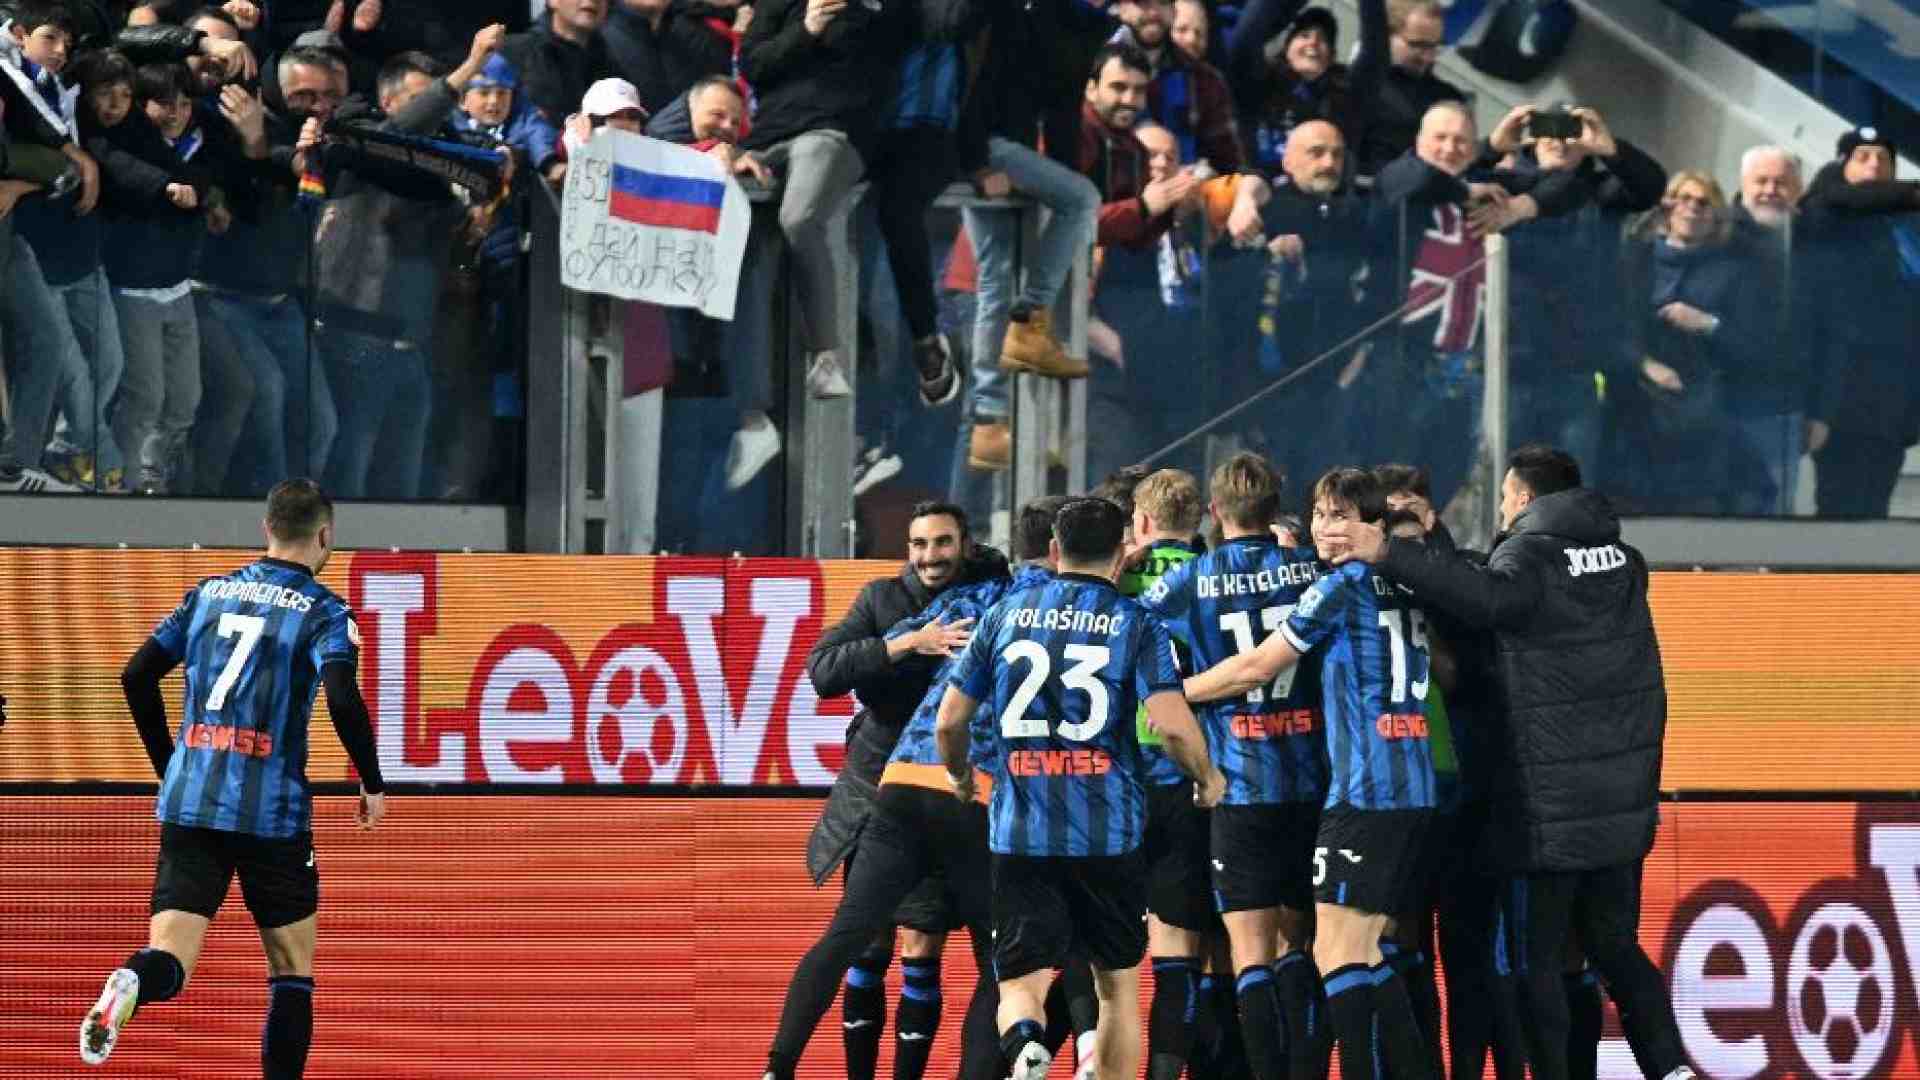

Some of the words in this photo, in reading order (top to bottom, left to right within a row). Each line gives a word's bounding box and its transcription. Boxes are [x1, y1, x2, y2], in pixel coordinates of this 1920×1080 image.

[200, 579, 315, 612] KOOPMEINERS
[1198, 576, 1220, 598] DE
[205, 612, 267, 711] 7
[361, 572, 858, 785] LeoVe
[1001, 639, 1110, 742] 23
[1219, 604, 1300, 703] 17
[1377, 608, 1430, 703] 15
[1375, 712, 1430, 738] GEW
[1313, 847, 1328, 886] 5
